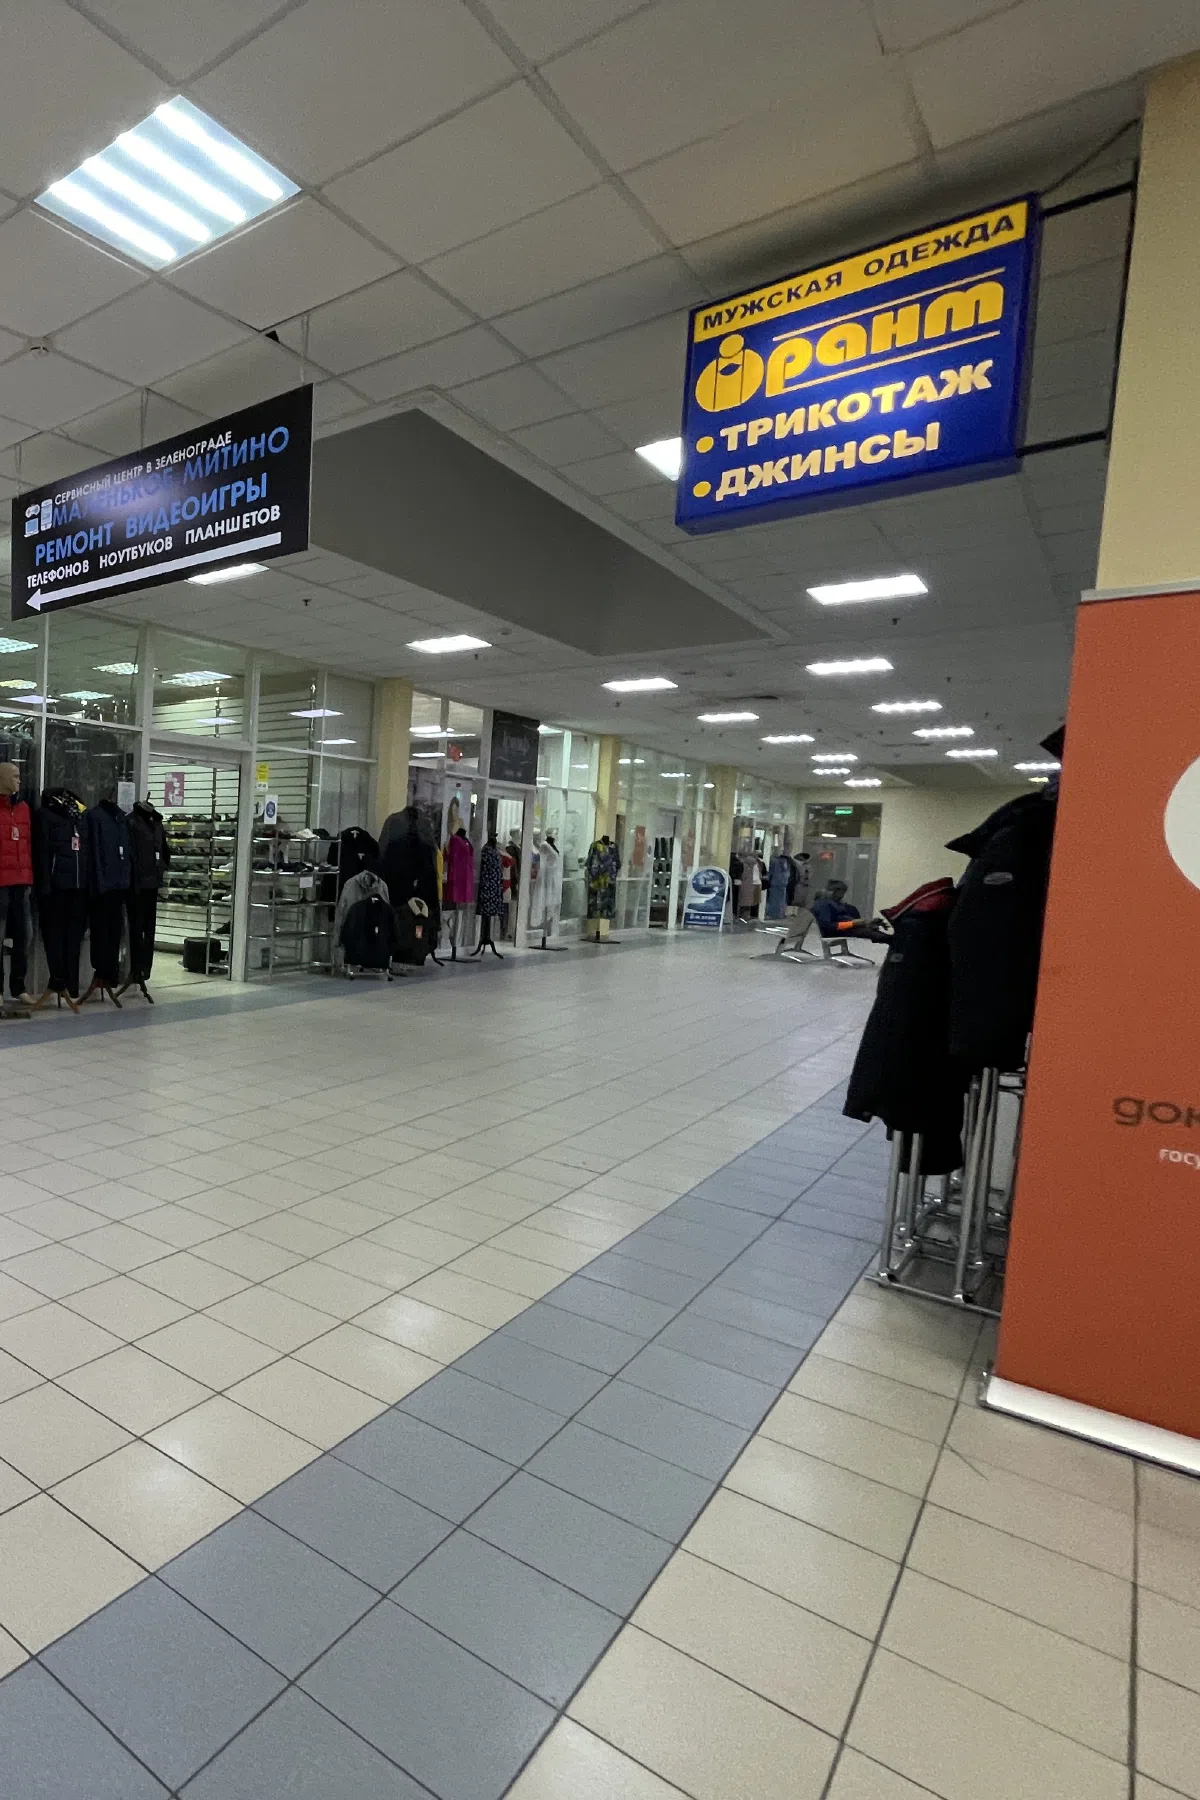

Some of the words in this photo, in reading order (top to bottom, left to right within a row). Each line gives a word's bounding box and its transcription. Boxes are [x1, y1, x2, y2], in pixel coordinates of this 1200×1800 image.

[702, 270, 843, 332] МУЖСКАЯ
[862, 213, 1015, 279] ОДЕЖДА
[719, 358, 994, 452] ТРИКОТАЖ
[54, 473, 112, 505] СЕРВИСНЫЙ
[113, 464, 144, 486] ЦЕНТР
[146, 461, 152, 473] В
[154, 430, 232, 471] ЗЕЛЕНОГРАДЕ
[183, 425, 290, 485] МИТИНО
[714, 421, 941, 502] ДЖИНСЫ
[26, 559, 90, 589] ТЕЛЕФОНОВ
[99, 536, 174, 569] НОУТБУКОВ
[184, 504, 281, 546] ПЛАНШЕТОВ
[35, 521, 114, 567] РЕМОНТ
[125, 472, 268, 540] ВИДЕОИГРЫ
